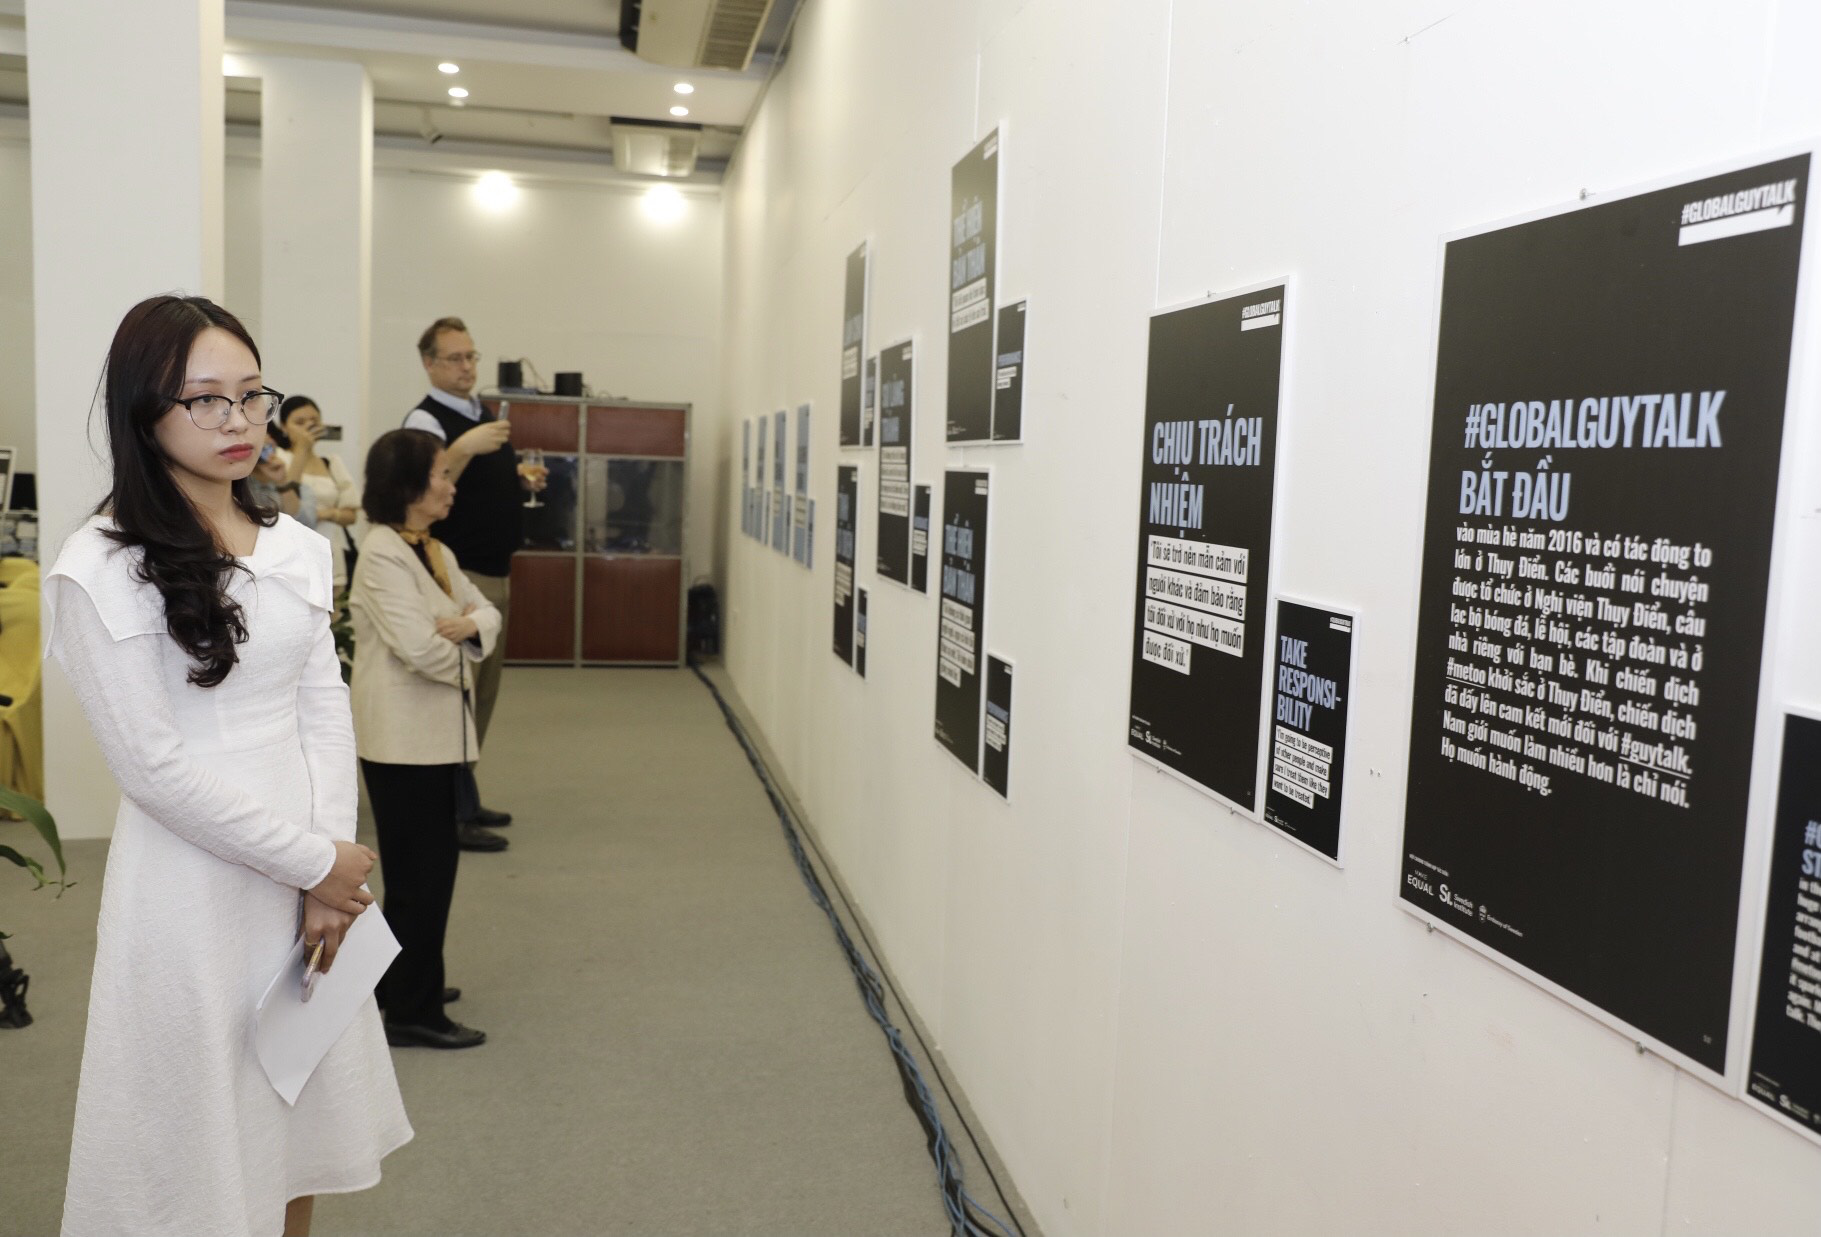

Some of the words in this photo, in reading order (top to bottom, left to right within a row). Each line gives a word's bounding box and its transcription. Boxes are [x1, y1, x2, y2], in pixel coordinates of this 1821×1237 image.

[1152, 420, 1194, 475] CHỊU
[1198, 403, 1262, 466] TRÁCH
[1464, 390, 1727, 449] #GLOBALGUYTALK
[1149, 471, 1204, 538] NHIỆM
[1459, 451, 1509, 517] BẮT
[1511, 455, 1571, 521] ĐẦU
[1454, 548, 1471, 570] lớn
[1475, 550, 1483, 572] ở
[1488, 552, 1514, 578] Thụy
[1518, 555, 1549, 581] Điển.
[1554, 560, 1579, 585] Các
[1585, 562, 1616, 590] buổi
[1621, 568, 1645, 594] nói
[1650, 572, 1709, 606] chuyện
[1457, 522, 1474, 542] vào
[1477, 524, 1500, 546] mùa
[1502, 525, 1516, 547] hè
[1519, 528, 1546, 550] năm
[1548, 530, 1582, 552] 2016
[1585, 532, 1600, 556] và
[1604, 534, 1620, 558] có
[1624, 536, 1648, 560] tác
[1650, 538, 1690, 570] động
[1694, 543, 1712, 568] to
[1450, 603, 1466, 627] lạc
[1468, 606, 1482, 632] bộ
[1484, 608, 1512, 637] bóng
[1514, 614, 1532, 640] đá,
[1534, 614, 1546, 640] lễ
[1549, 620, 1572, 648] hội,
[1575, 626, 1598, 651] các
[1602, 632, 1626, 660] tập
[1628, 636, 1666, 664] đoàn
[1669, 642, 1688, 668] và
[1692, 644, 1703, 672] ở
[1452, 576, 1478, 602] được
[1480, 578, 1494, 601] tổ
[1494, 581, 1522, 606] chức
[1524, 585, 1532, 608] ở
[1534, 588, 1564, 618] Nghị
[1566, 594, 1594, 622] viện
[1597, 596, 1630, 628] Thụy
[1632, 601, 1671, 634] Điển,
[1675, 610, 1706, 638] câu
[1280, 635, 1308, 669] TAKE
[1448, 632, 1468, 653] nhà
[1473, 636, 1501, 664] riêng
[1507, 643, 1524, 665] với
[1530, 647, 1552, 674] bạn
[1559, 653, 1578, 678] bè.
[1586, 658, 1608, 685] Khi
[1616, 666, 1656, 696] chiến
[1664, 676, 1699, 707] dịch
[1276, 693, 1313, 731] BILITY
[1279, 665, 1341, 710] RESPONSI-
[1447, 656, 1486, 686] #metoo
[1488, 666, 1512, 692] khởi
[1514, 672, 1535, 697] sắc
[1537, 677, 1546, 700] ở
[1548, 681, 1578, 712] Thụy
[1580, 688, 1615, 722] Điển,
[1618, 700, 1658, 730] chiến
[1661, 710, 1696, 740] dịch
[1443, 710, 1466, 734] Nam
[1468, 719, 1488, 742] giới
[1490, 729, 1521, 753] muốn
[1524, 734, 1546, 762] làm
[1549, 744, 1585, 774] nhiều
[1588, 754, 1614, 784] hơn
[1616, 764, 1630, 789] là
[1634, 772, 1658, 797] chỉ
[1660, 782, 1690, 809] nói.
[1444, 684, 1458, 704] đã
[1460, 688, 1478, 713] dấy
[1480, 692, 1496, 716] lên
[1498, 703, 1523, 724] cam
[1525, 705, 1546, 731] kết
[1548, 713, 1572, 738] mới
[1574, 720, 1596, 746] đối
[1598, 726, 1619, 752] với
[1621, 732, 1693, 775] #guytalk.
[1441, 736, 1455, 763] Họ
[1457, 746, 1486, 770] muốn
[1489, 753, 1517, 781] hành
[1519, 764, 1552, 796] động.
[1407, 874, 1434, 896] EQUAL
